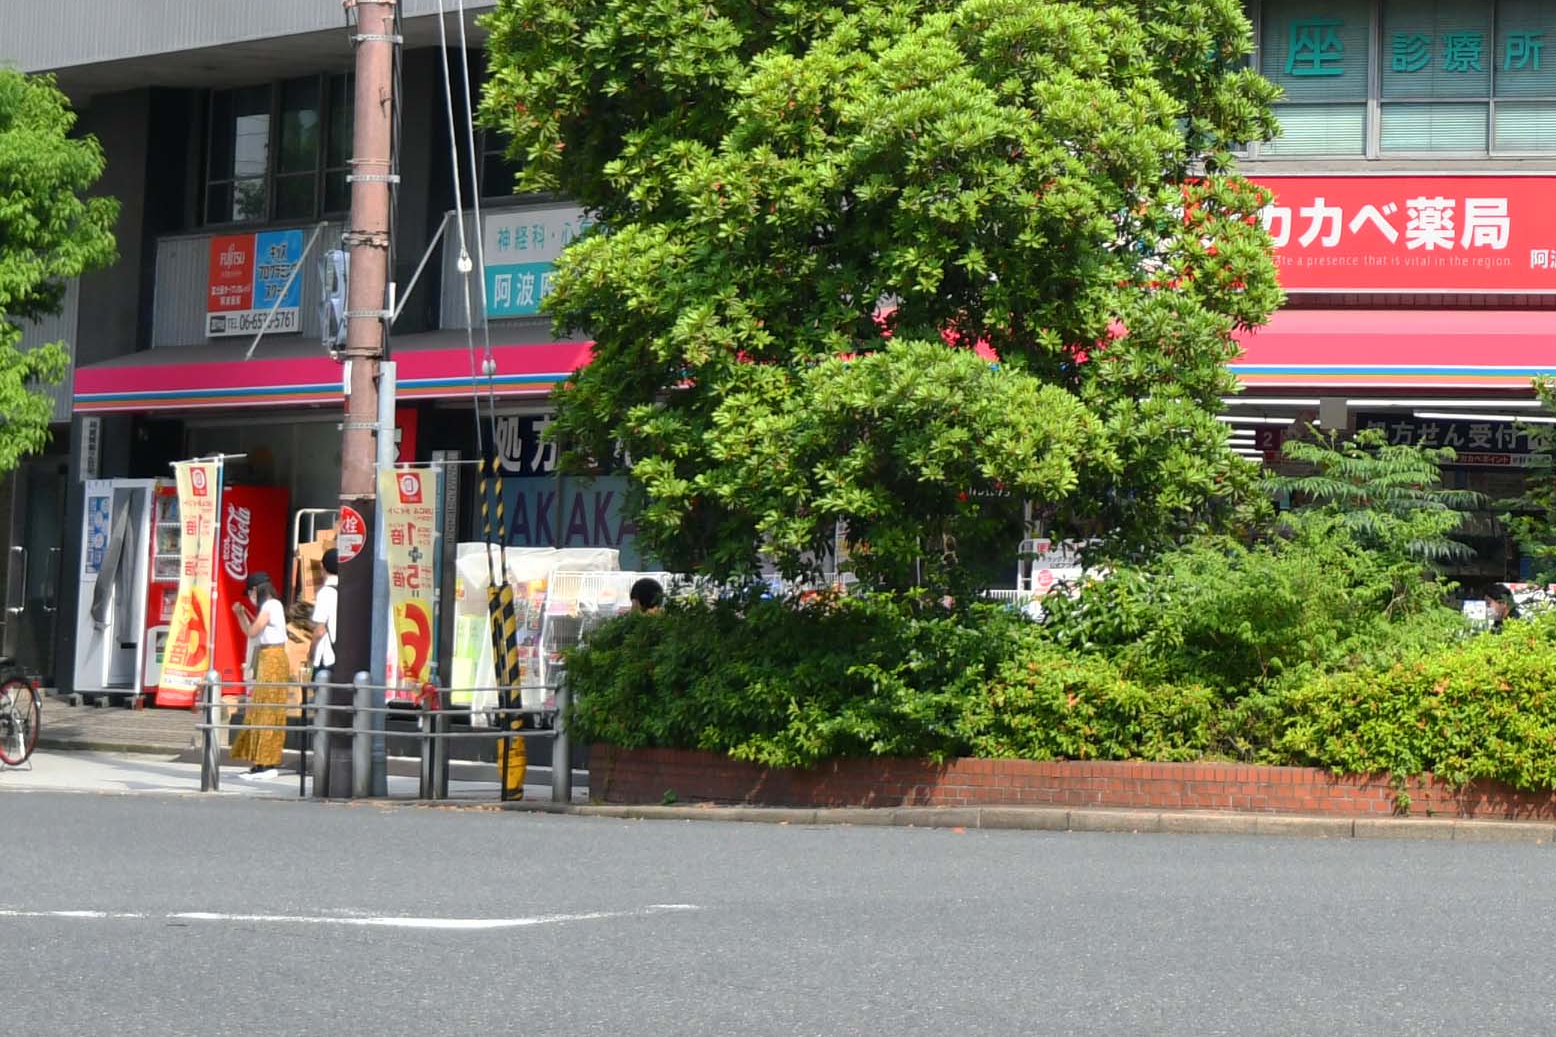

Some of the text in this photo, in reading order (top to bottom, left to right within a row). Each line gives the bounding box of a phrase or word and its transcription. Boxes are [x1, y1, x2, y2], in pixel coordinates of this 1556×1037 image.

[1391, 29, 1545, 74] 診療所
[1252, 196, 1511, 251] カカベ薬局
[1307, 256, 1359, 269] presence
[1364, 255, 1387, 266] that
[1404, 255, 1431, 267] vital
[1434, 256, 1446, 267] in
[1449, 255, 1469, 267] the
